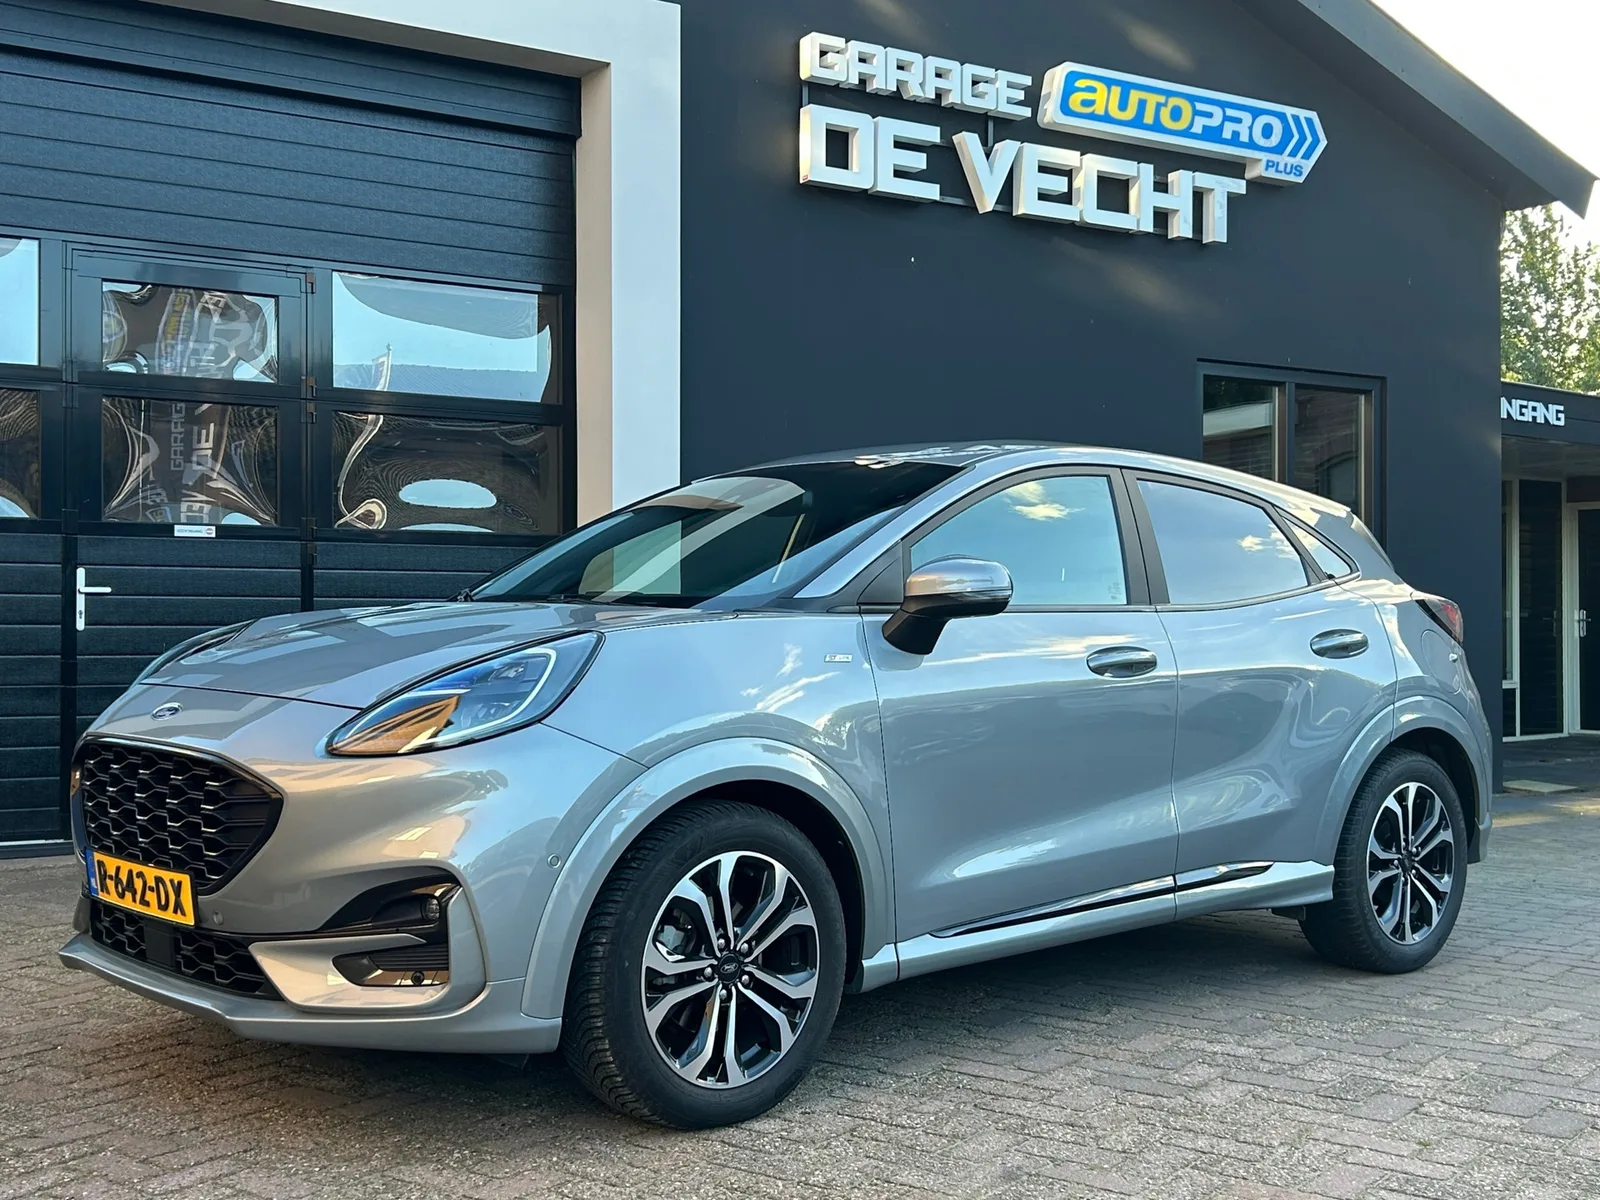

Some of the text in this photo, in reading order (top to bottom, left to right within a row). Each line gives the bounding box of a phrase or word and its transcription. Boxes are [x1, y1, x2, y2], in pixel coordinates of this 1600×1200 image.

[800, 31, 1032, 121] GARAGE
[800, 104, 1246, 244] DE VECHT
[1265, 160, 1304, 177] PLUS
[96, 859, 187, 917] R-642-DX
